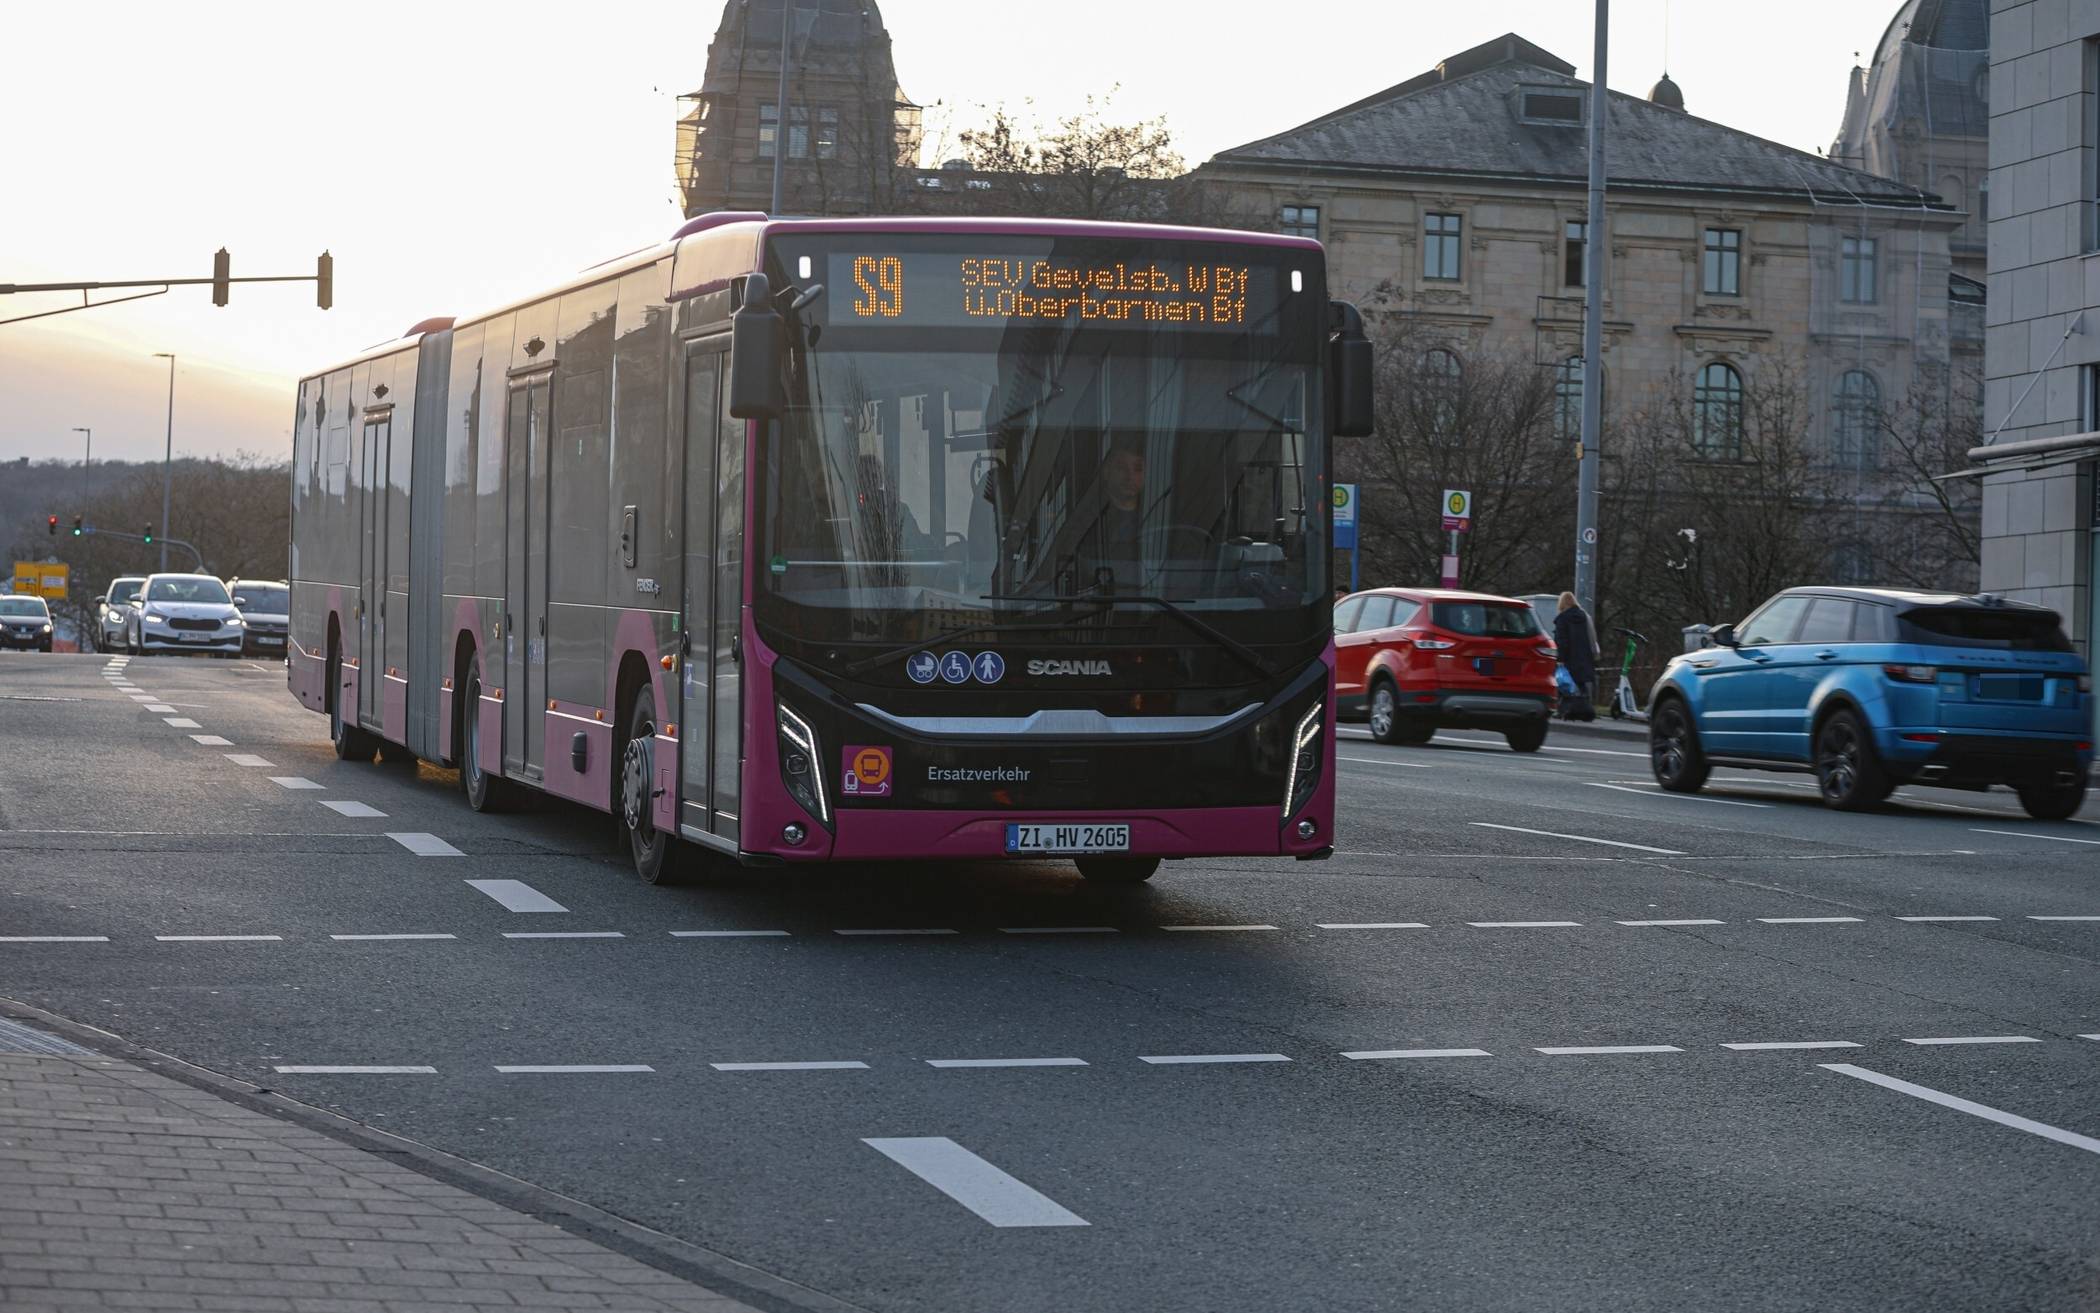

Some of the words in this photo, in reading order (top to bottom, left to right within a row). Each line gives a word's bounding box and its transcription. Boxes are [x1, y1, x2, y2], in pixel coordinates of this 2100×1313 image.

[855, 256, 901, 317] S9
[961, 258, 1023, 287] SEV
[1032, 261, 1180, 293] Gevelsb.
[1188, 266, 1207, 293] W
[1216, 267, 1248, 294] Bf
[1213, 295, 1245, 322] Bf
[1027, 659, 1112, 676] SCANIA
[928, 766, 1031, 781] Ersatzverkehr
[1019, 827, 1041, 848] ZI
[1056, 827, 1079, 848] HV
[1083, 827, 1127, 848] 2605
